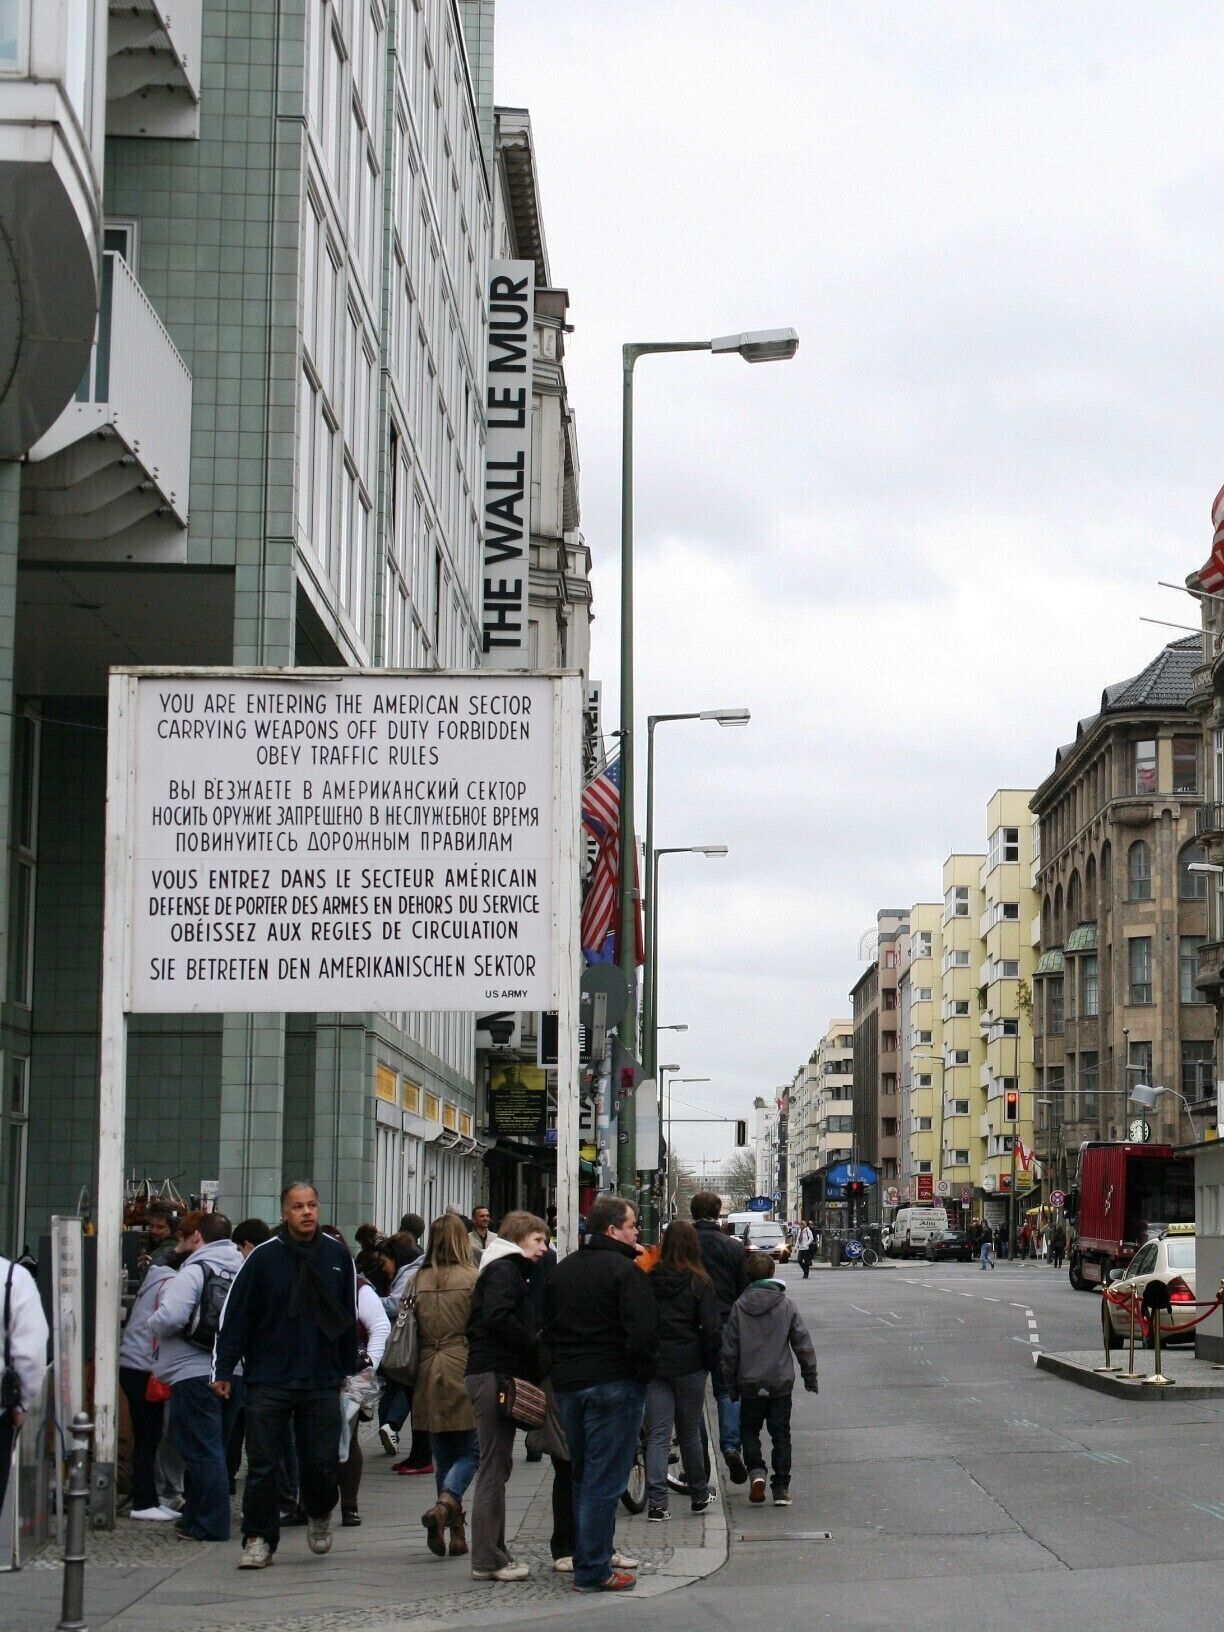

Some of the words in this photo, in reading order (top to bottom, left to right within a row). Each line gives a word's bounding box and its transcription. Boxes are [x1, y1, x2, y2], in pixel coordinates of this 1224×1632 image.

[488, 276, 529, 373] MUR
[487, 387, 526, 428] LE
[485, 451, 524, 565] WALL
[483, 578, 522, 653] THE
[159, 693, 194, 714] YOU
[204, 693, 236, 714] ARE
[246, 693, 327, 715] ENTERING
[336, 693, 362, 714] THE
[373, 694, 459, 715] AMERICAN
[468, 695, 532, 716] SECTOR
[157, 719, 247, 740] CARRYING
[254, 719, 339, 740] WEAPONS
[347, 719, 377, 740] OFF
[388, 720, 429, 740] DUTY
[438, 720, 530, 740] FORBIDDEN
[256, 745, 302, 766] OBEY
[311, 745, 379, 766] TRAFFIC
[389, 745, 439, 766] RULES
[169, 779, 195, 800] ВЫ
[303, 780, 313, 800] В
[322, 777, 459, 801] АМЕРИКАНСКИЙ
[466, 780, 527, 801] СЕКТОР
[152, 805, 208, 826] НОСИТЬ
[212, 805, 272, 827] ОРУЖИЕ
[369, 805, 380, 826] В
[385, 805, 487, 827] НЕСЛУЖЕБНОЕ
[493, 806, 539, 827] ВРЕМЯ
[307, 831, 409, 852] ДОРОЖНЫМ
[421, 831, 513, 852] ПРАВИЛАМ
[151, 868, 198, 890] VOUS
[209, 869, 270, 890] ENTREZ
[281, 868, 327, 889] DANS
[336, 868, 351, 889] LE
[361, 868, 435, 889] SECTEUR
[445, 862, 537, 888] AMÉRICAIN
[149, 896, 211, 917] DEFENSE
[214, 896, 238, 916] DE
[235, 895, 288, 916] PORTER
[291, 895, 319, 915] DES
[322, 895, 369, 915] ARMES
[373, 895, 392, 915] EN
[398, 894, 453, 915] DEHORS
[459, 894, 478, 914] DU
[482, 894, 540, 914] SERVICE
[170, 918, 257, 943] OBÉISSEZ
[267, 922, 302, 942] AUX
[311, 920, 372, 941] REGLES
[382, 921, 402, 941] DE
[411, 919, 518, 940] CIRCULATION
[150, 957, 176, 981] SIE
[186, 958, 269, 981] BETRETEN
[278, 957, 310, 980] DEN
[318, 954, 465, 979] AMERIKANISCHEN
[474, 954, 536, 977] SEKTOR
[485, 989, 499, 999] US
[501, 989, 528, 998] ARMY
